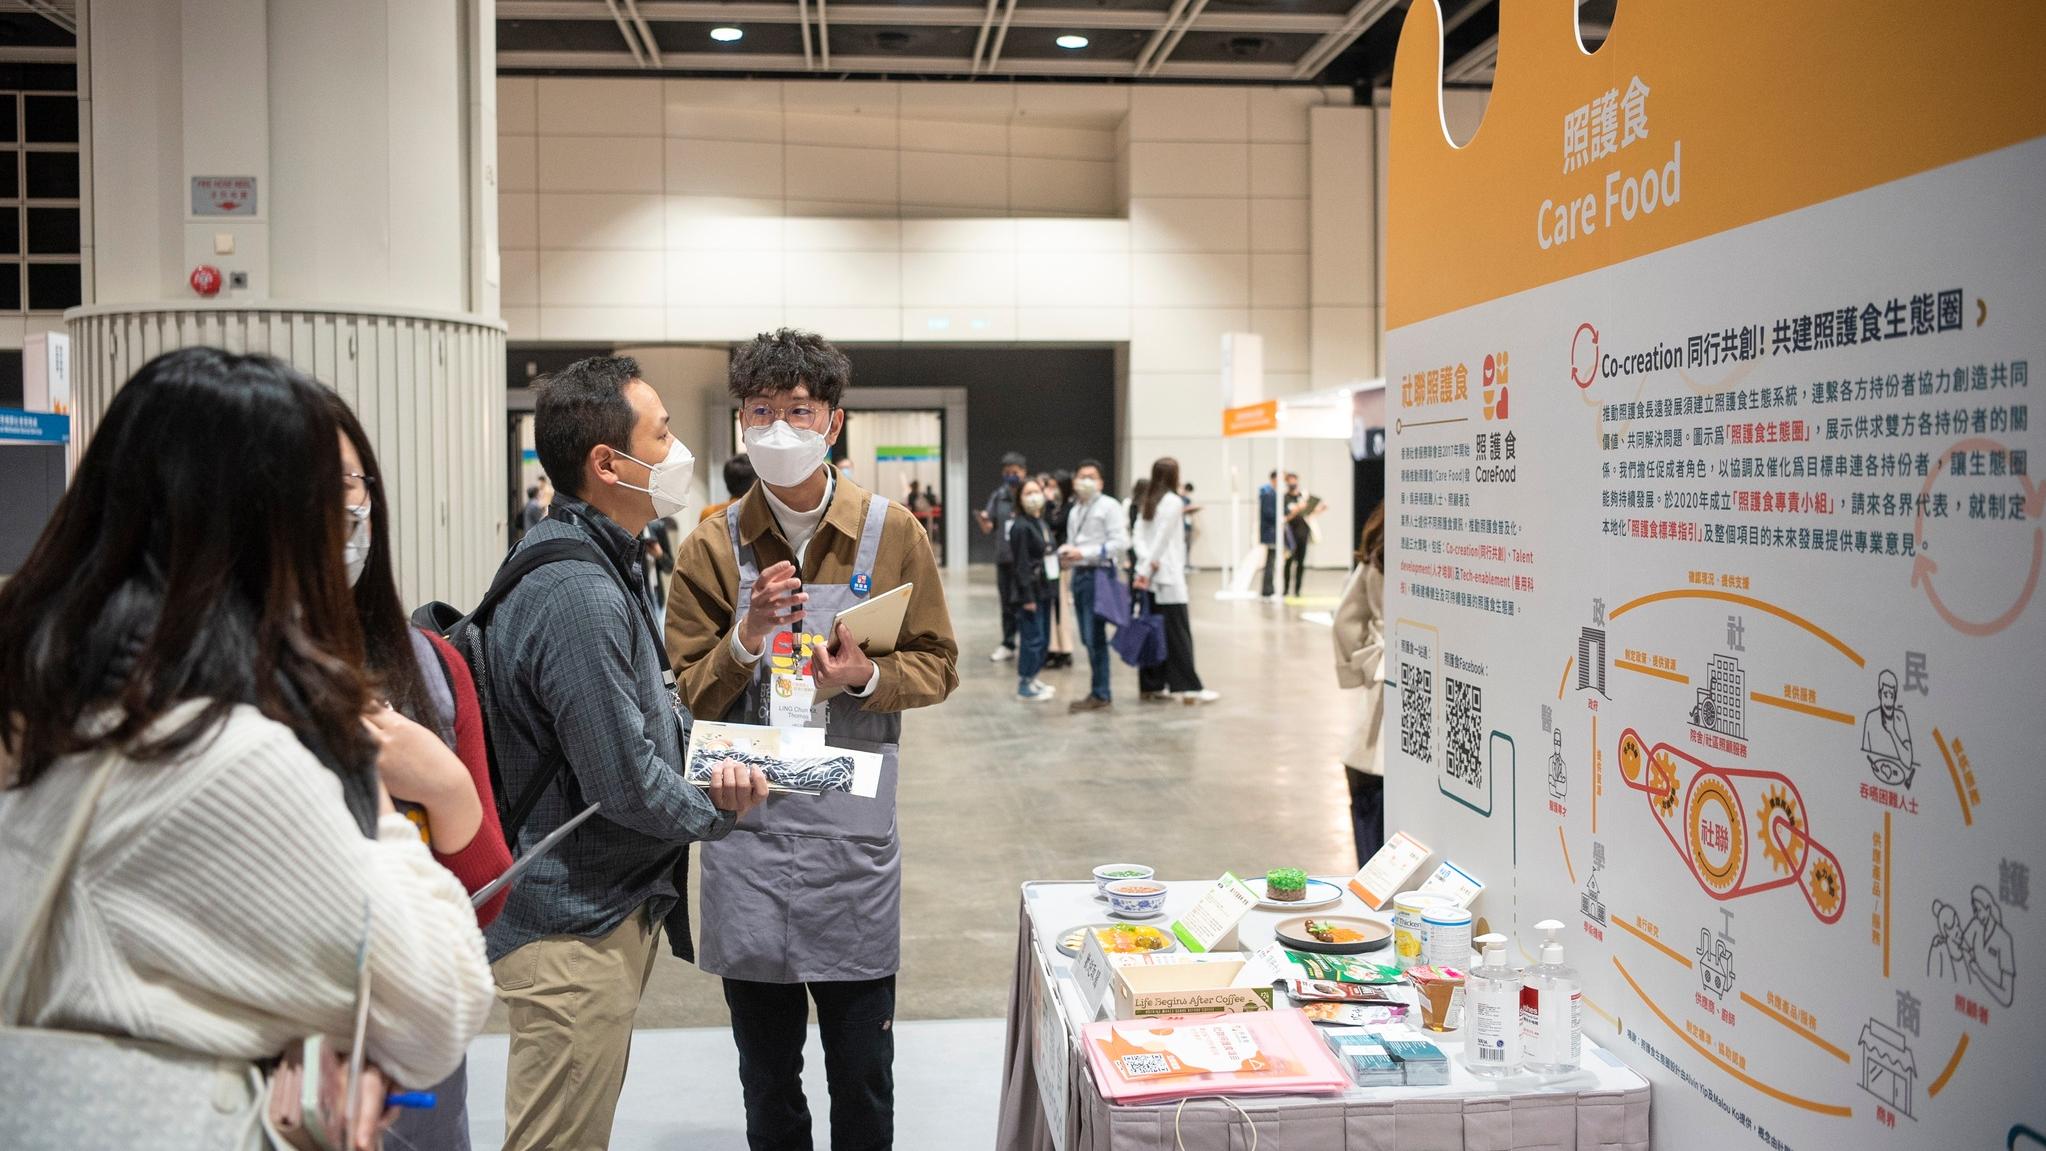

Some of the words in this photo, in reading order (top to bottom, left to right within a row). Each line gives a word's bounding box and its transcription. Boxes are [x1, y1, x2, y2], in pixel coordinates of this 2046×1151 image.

[1563, 75, 1651, 175] 照護食
[1537, 198, 1596, 250] Care
[1604, 141, 1682, 228] Food
[1602, 343, 1683, 378] Co-creation
[1772, 288, 1963, 357] 共建照護食生態圈
[1402, 363, 1469, 408] 社聯照護食
[1476, 430, 1517, 461] 照護食
[1476, 465, 1516, 483] CareFood
[1592, 597, 1606, 627] 政
[1727, 615, 1745, 652] 社
[1903, 651, 1929, 696] 民
[1701, 819, 1729, 854] 社聯
[1719, 907, 1735, 945] 工
[1135, 998, 1153, 1009] Life
[1155, 996, 1187, 1008] Begins
[1189, 993, 1214, 1006] After
[1216, 992, 1246, 1005] Coffee
[1896, 989, 1922, 1038] 商
